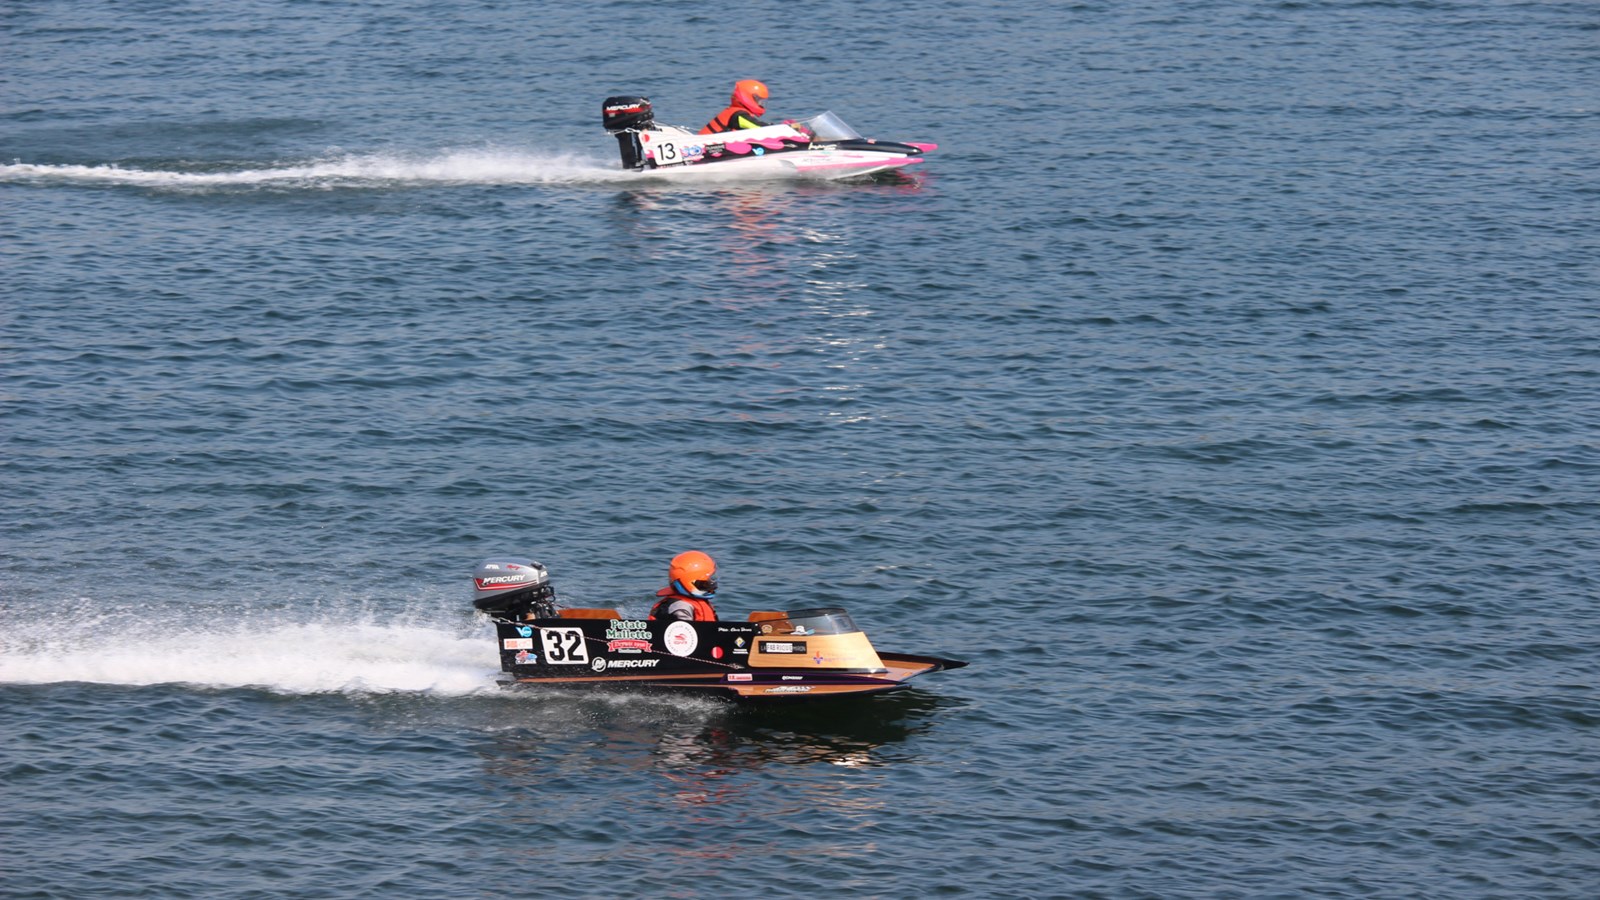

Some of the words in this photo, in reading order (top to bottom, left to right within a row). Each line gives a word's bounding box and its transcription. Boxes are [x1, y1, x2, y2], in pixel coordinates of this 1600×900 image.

[606, 103, 641, 111] MERCURY
[657, 143, 676, 161] 13
[483, 574, 525, 585] MERCURY
[609, 619, 648, 630] Patate
[605, 629, 653, 640] Mallette
[546, 630, 585, 661] 32
[607, 659, 660, 668] MERCURY
